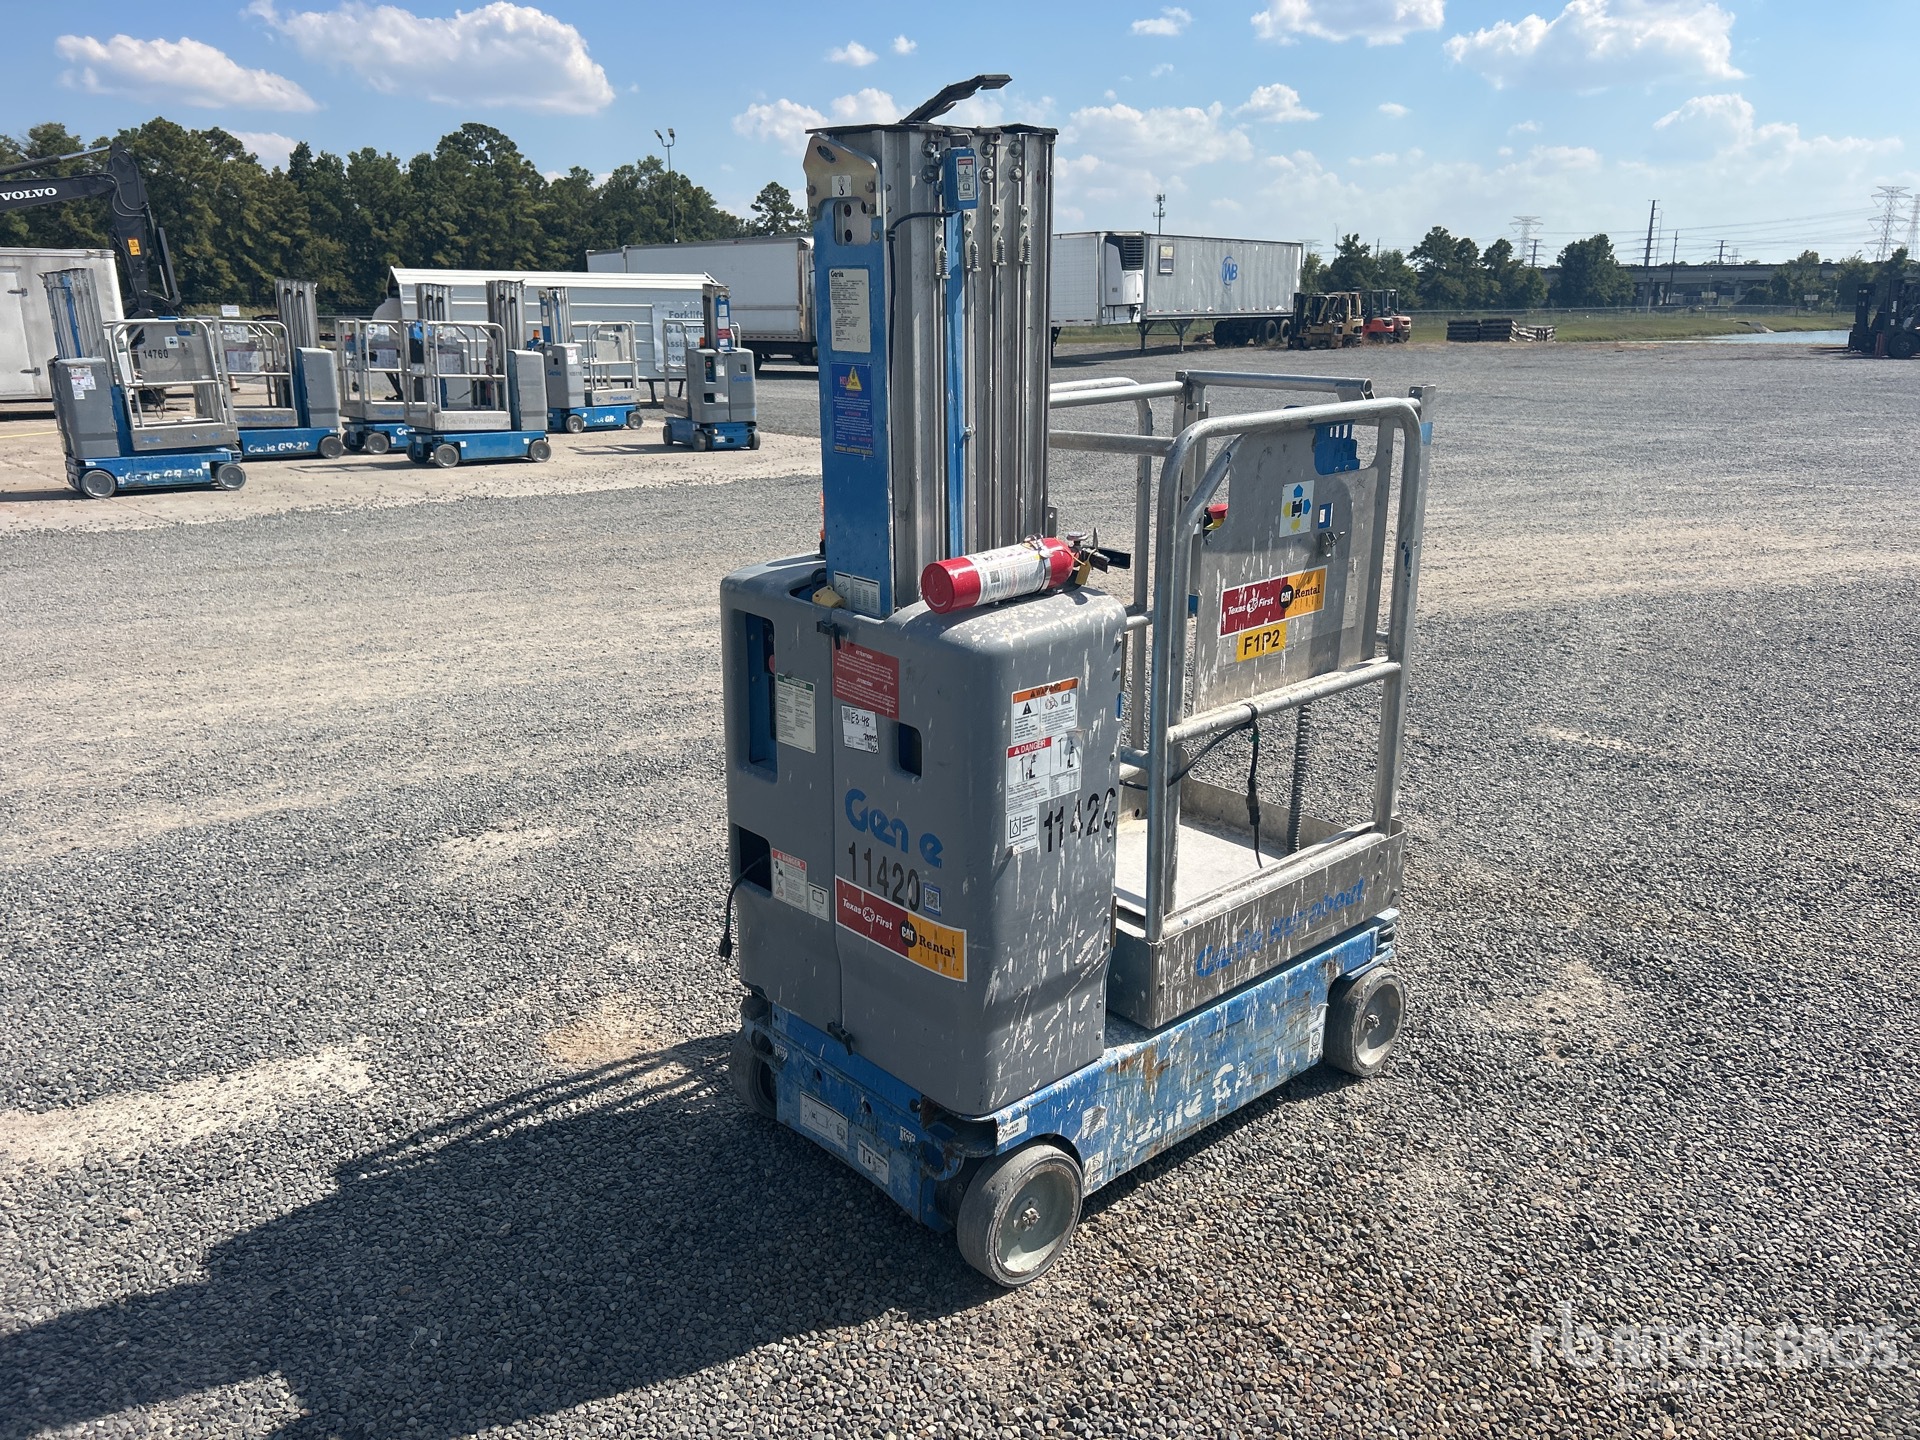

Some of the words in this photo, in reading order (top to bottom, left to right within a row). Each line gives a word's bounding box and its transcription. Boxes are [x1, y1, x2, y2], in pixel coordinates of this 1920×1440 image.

[0, 187, 57, 201] VOLVO
[143, 349, 169, 359] 14760
[1228, 604, 1246, 616] Texas
[1258, 596, 1274, 608] First
[1280, 590, 1292, 603] CAT
[1293, 583, 1321, 600] Rental
[1243, 629, 1281, 656] F1P2
[1020, 739, 1046, 754] DANGER
[844, 788, 944, 869] Gene
[848, 841, 921, 913] 11420
[842, 897, 863, 915] Texas
[875, 914, 893, 931] First
[901, 926, 914, 942] CAT
[918, 934, 957, 959] Rental
